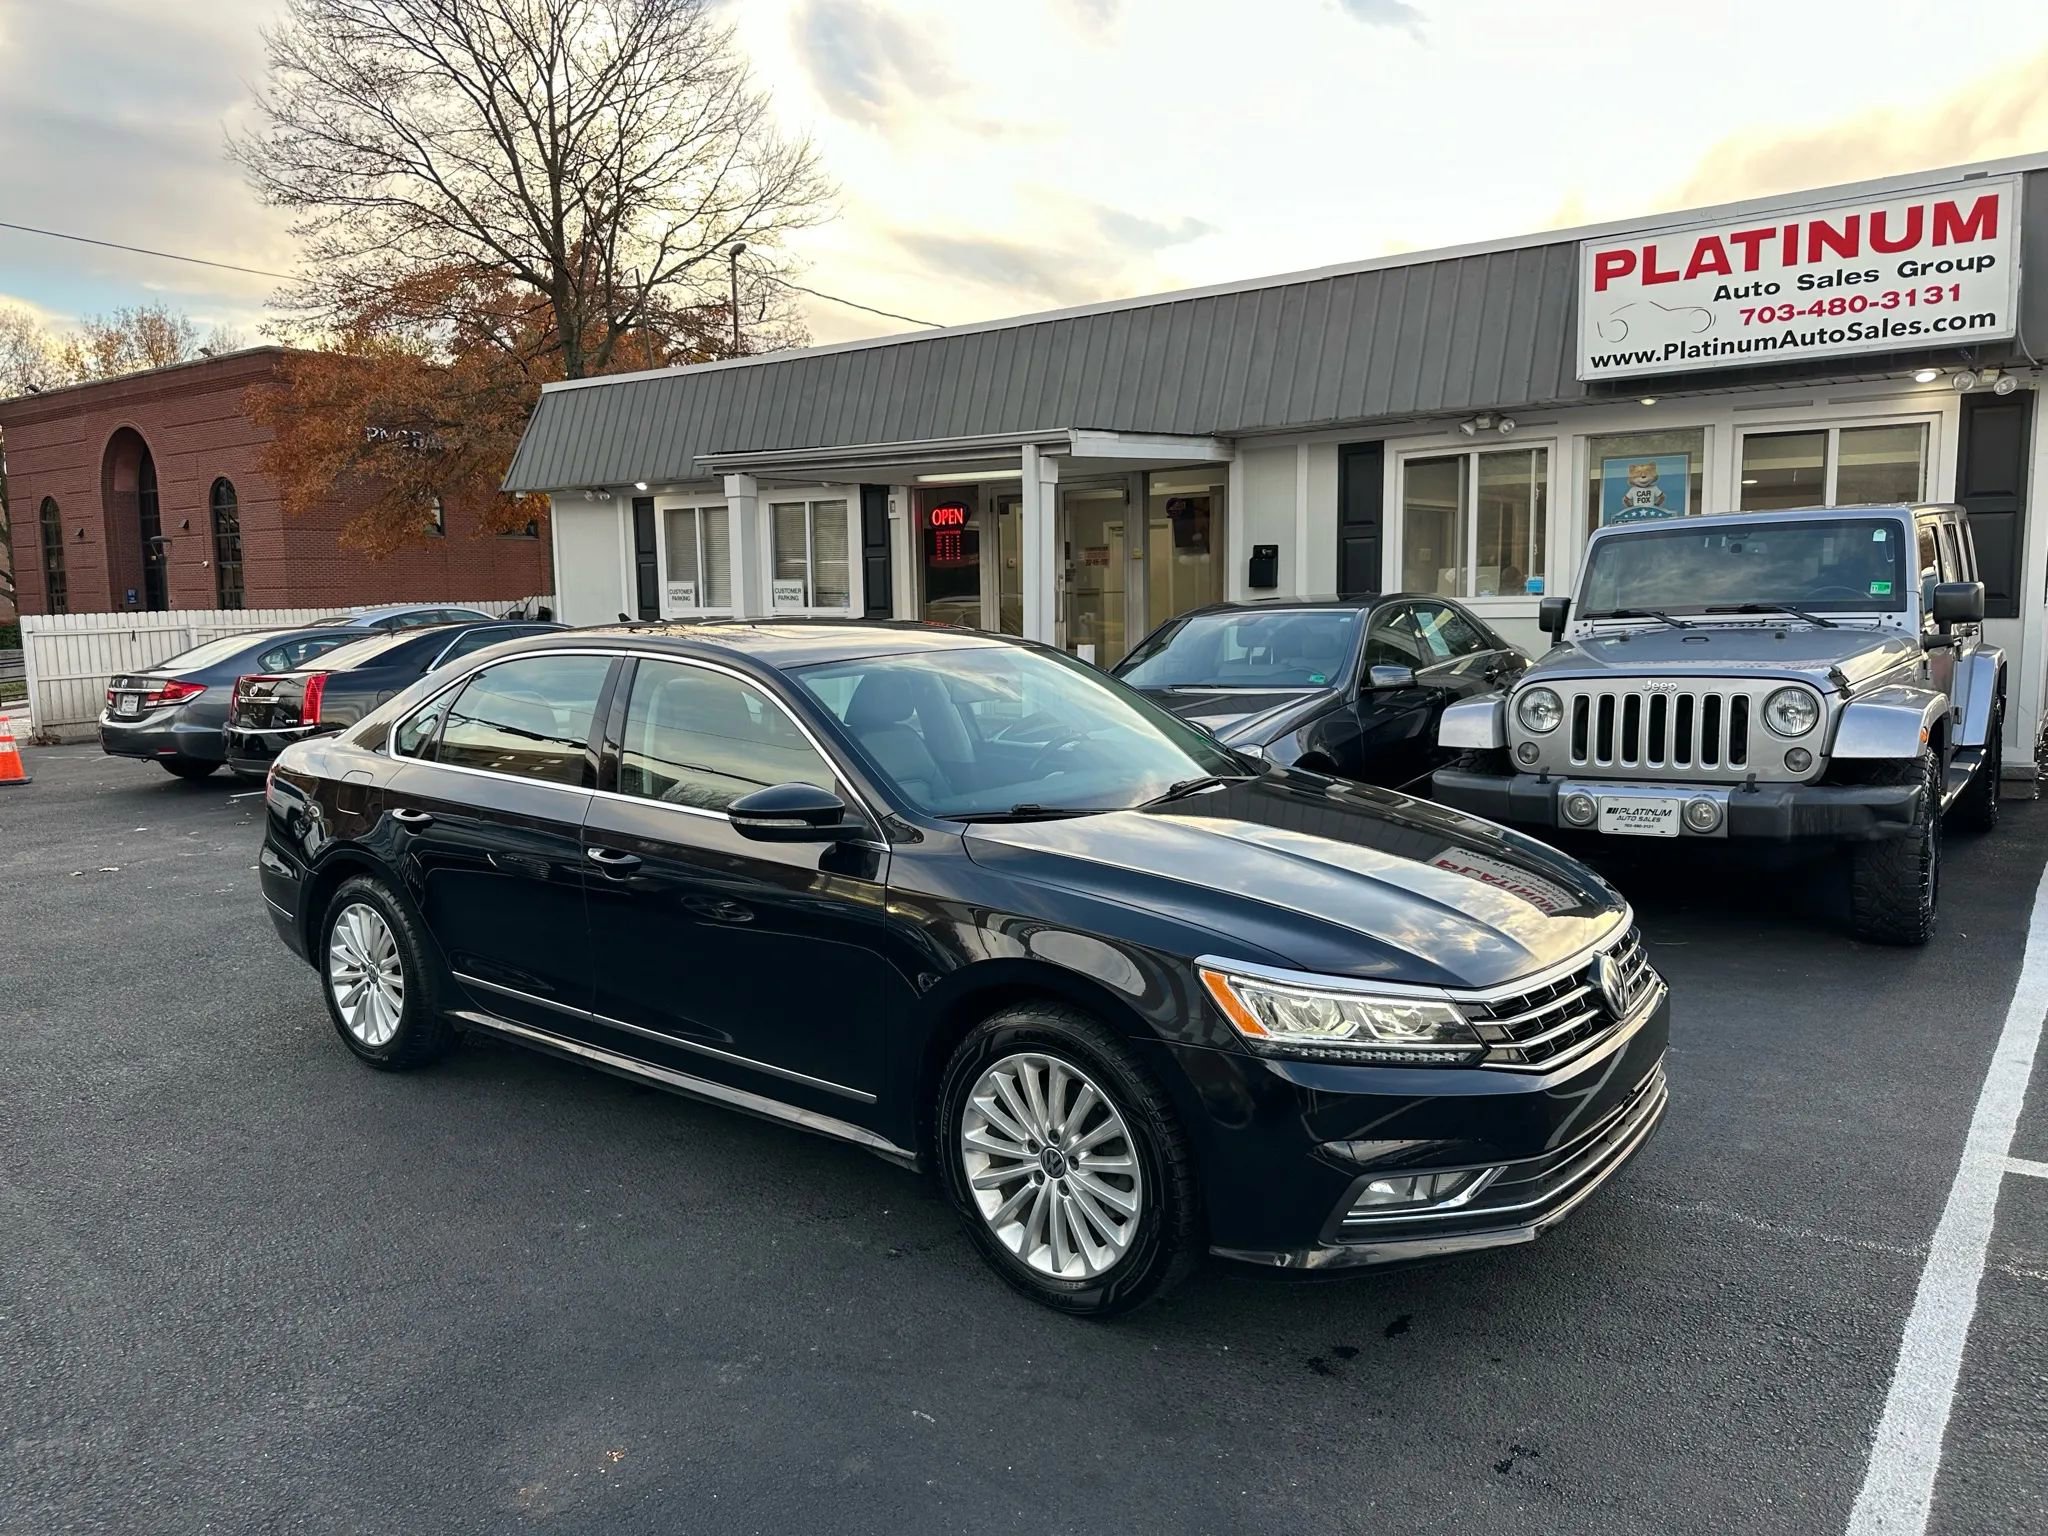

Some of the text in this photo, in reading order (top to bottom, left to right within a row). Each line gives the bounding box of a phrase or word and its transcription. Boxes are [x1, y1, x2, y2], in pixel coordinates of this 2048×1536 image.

[1594, 194, 1999, 292] PLATINUM
[1712, 254, 1996, 302] Auto Sales Group
[1739, 284, 1960, 326] 703-480-3131
[1590, 312, 1996, 369] www.PlatinumAutoSales.com
[932, 508, 964, 526] OPEN
[1641, 679, 1678, 693] Jeep
[1618, 807, 1673, 817] PLATINUM
